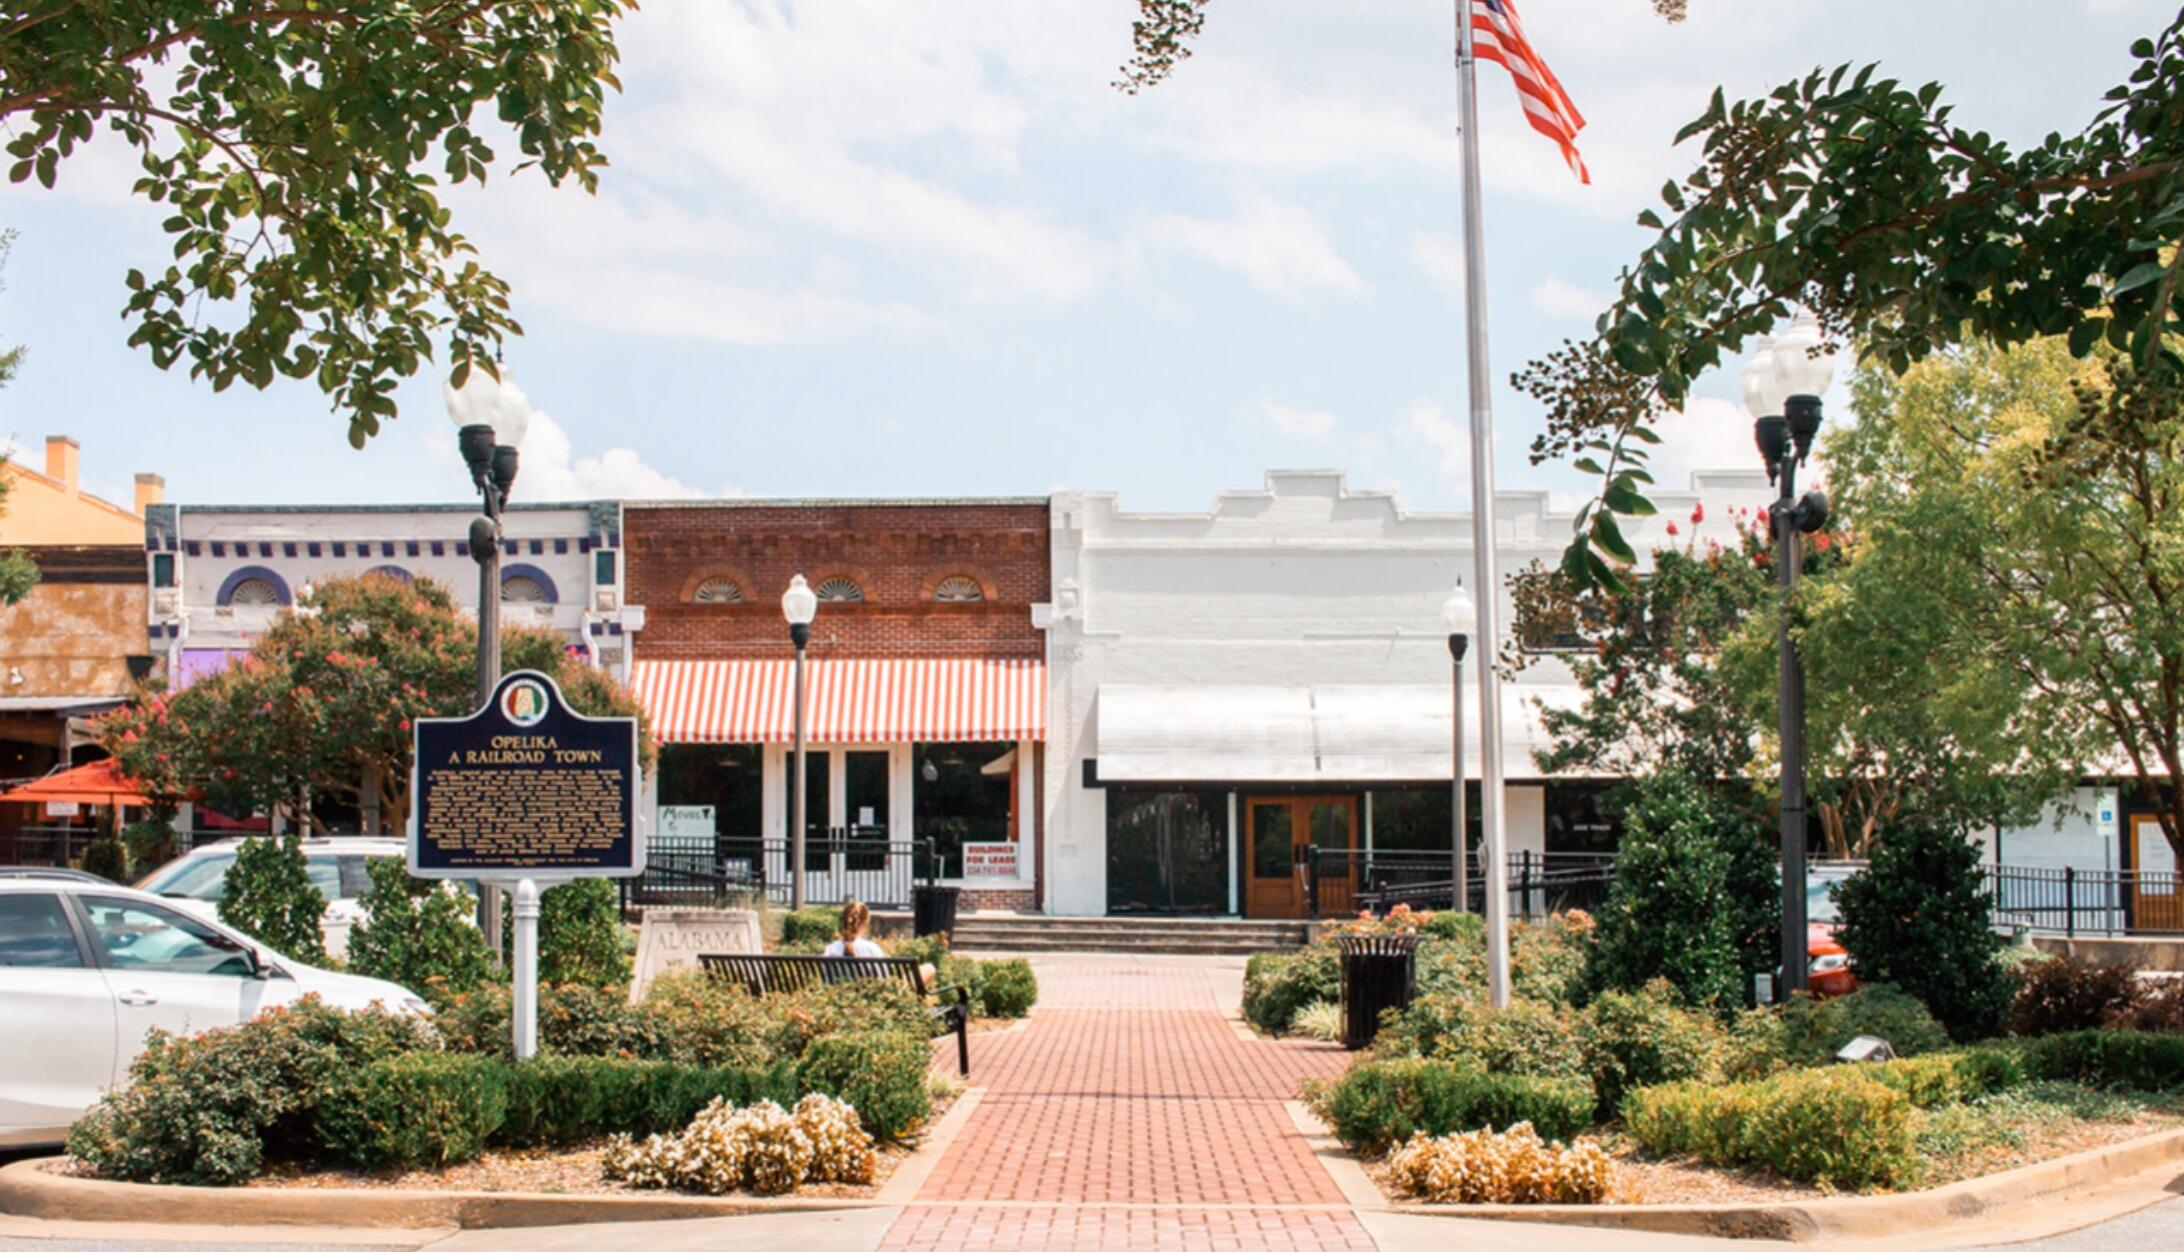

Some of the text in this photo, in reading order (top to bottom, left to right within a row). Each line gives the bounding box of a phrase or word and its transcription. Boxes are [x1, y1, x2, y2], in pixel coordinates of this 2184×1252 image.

[491, 735, 558, 749] OPELIKA
[448, 750, 602, 764] A RAILROAD TOWN
[966, 855, 1016, 864] FOR LEASE
[656, 931, 744, 950] ALABAMA
